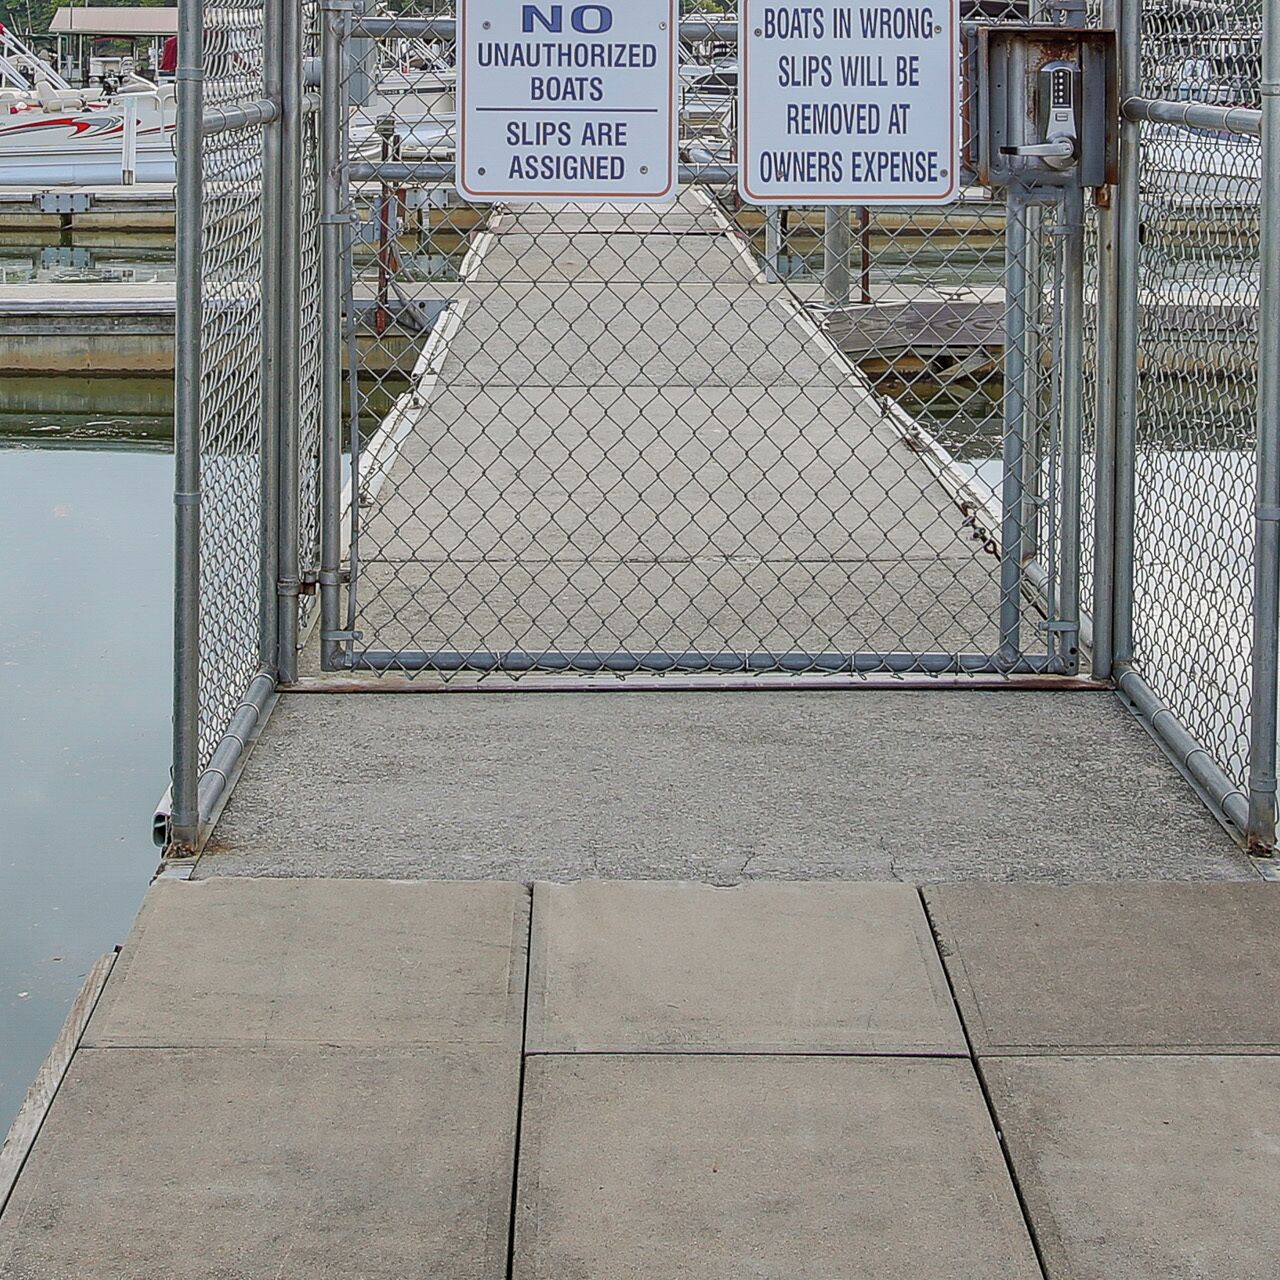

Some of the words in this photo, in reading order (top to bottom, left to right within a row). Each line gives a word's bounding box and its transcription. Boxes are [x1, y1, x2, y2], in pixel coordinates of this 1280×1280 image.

[522, 5, 612, 33] NO
[765, 8, 824, 39] BOATS
[834, 8, 851, 38] IN
[860, 8, 932, 39] WRONG
[478, 43, 656, 67] UNAUTHORIZED
[779, 56, 832, 87] SLIPS
[841, 56, 890, 87] WILL
[897, 56, 919, 87] BE
[531, 77, 603, 102] BOATS
[788, 104, 879, 134] REMOVED
[888, 104, 910, 134] AT
[507, 122, 571, 146] SLIPS
[581, 123, 627, 146] ARE
[509, 155, 624, 179] ASSIGNED
[760, 151, 842, 182] OWNERS
[852, 151, 937, 182] EXPENSE
